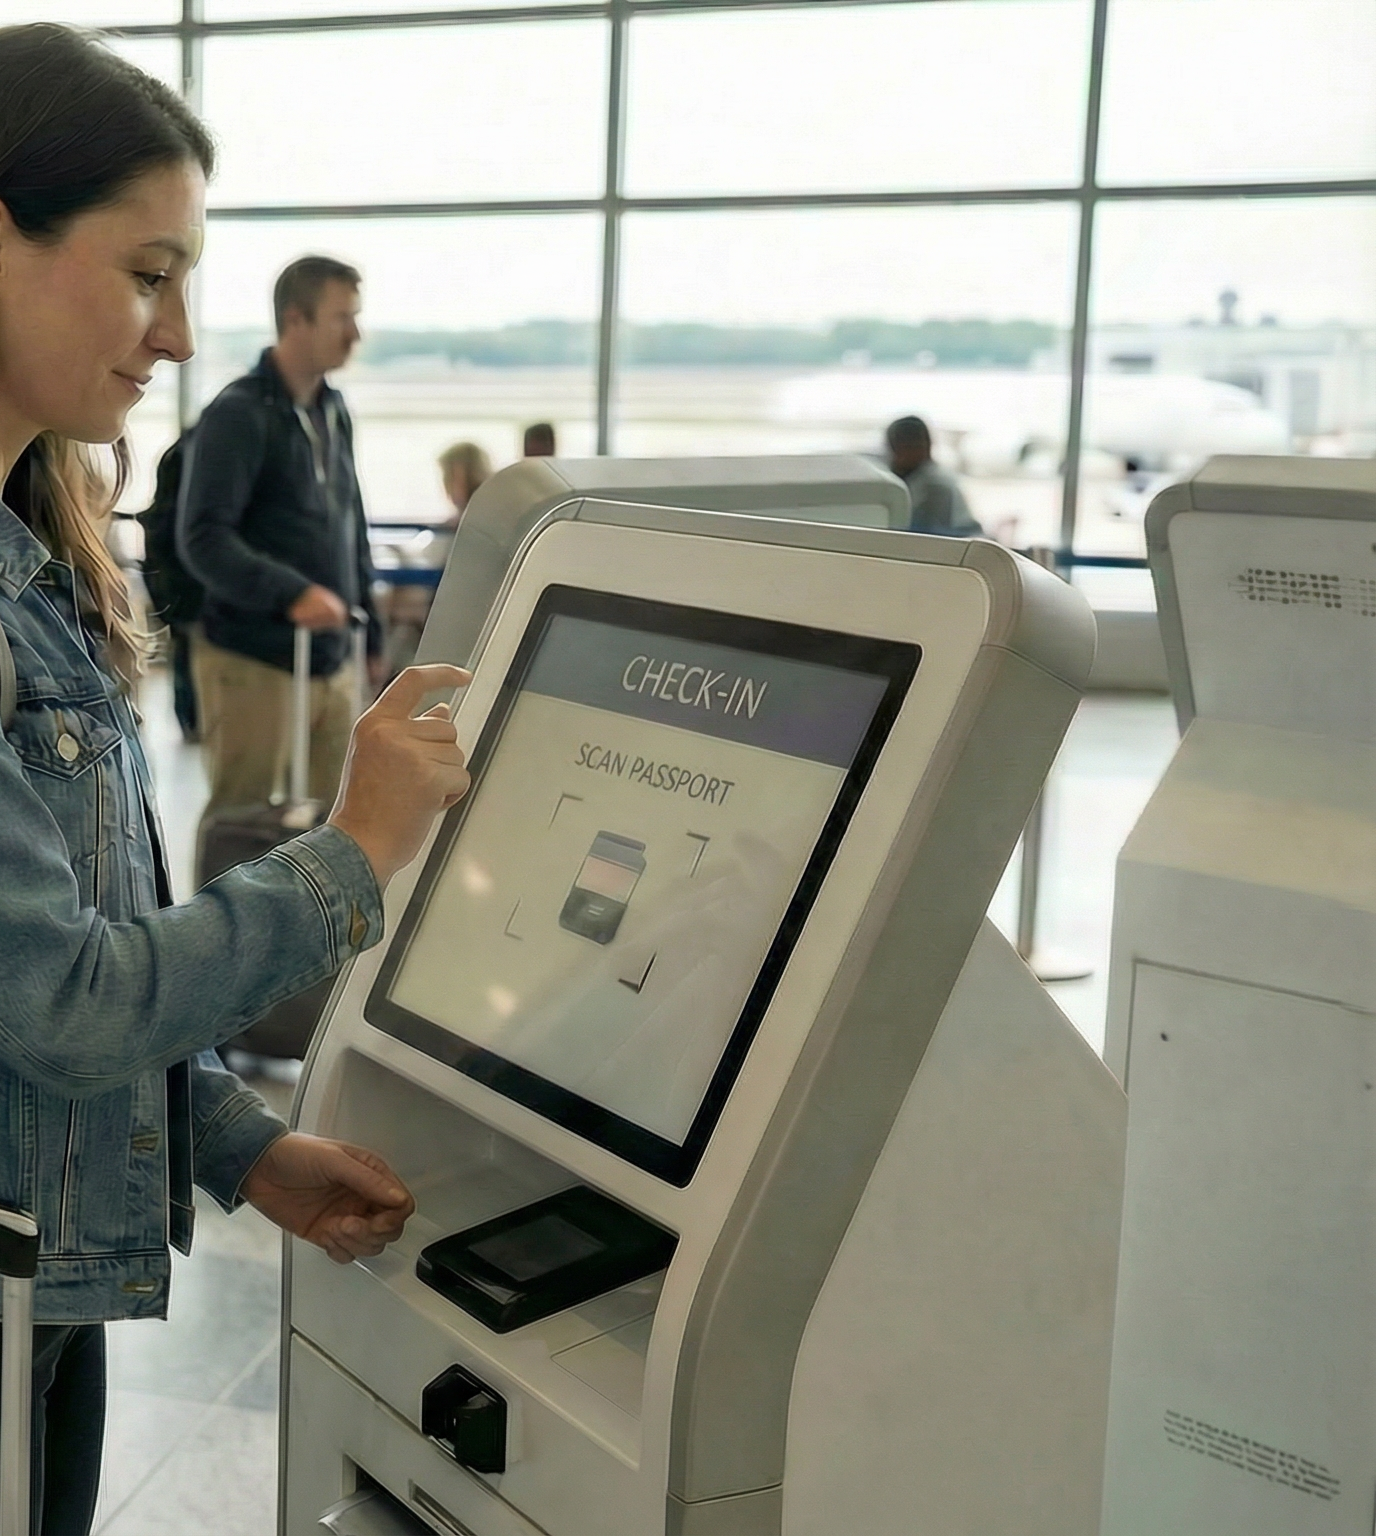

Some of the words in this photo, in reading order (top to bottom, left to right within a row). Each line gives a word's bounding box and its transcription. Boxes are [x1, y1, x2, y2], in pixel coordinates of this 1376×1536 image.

[621, 654, 768, 719] CHECK-IN
[574, 742, 628, 777] SCAN
[629, 756, 735, 806] PASSPORT
